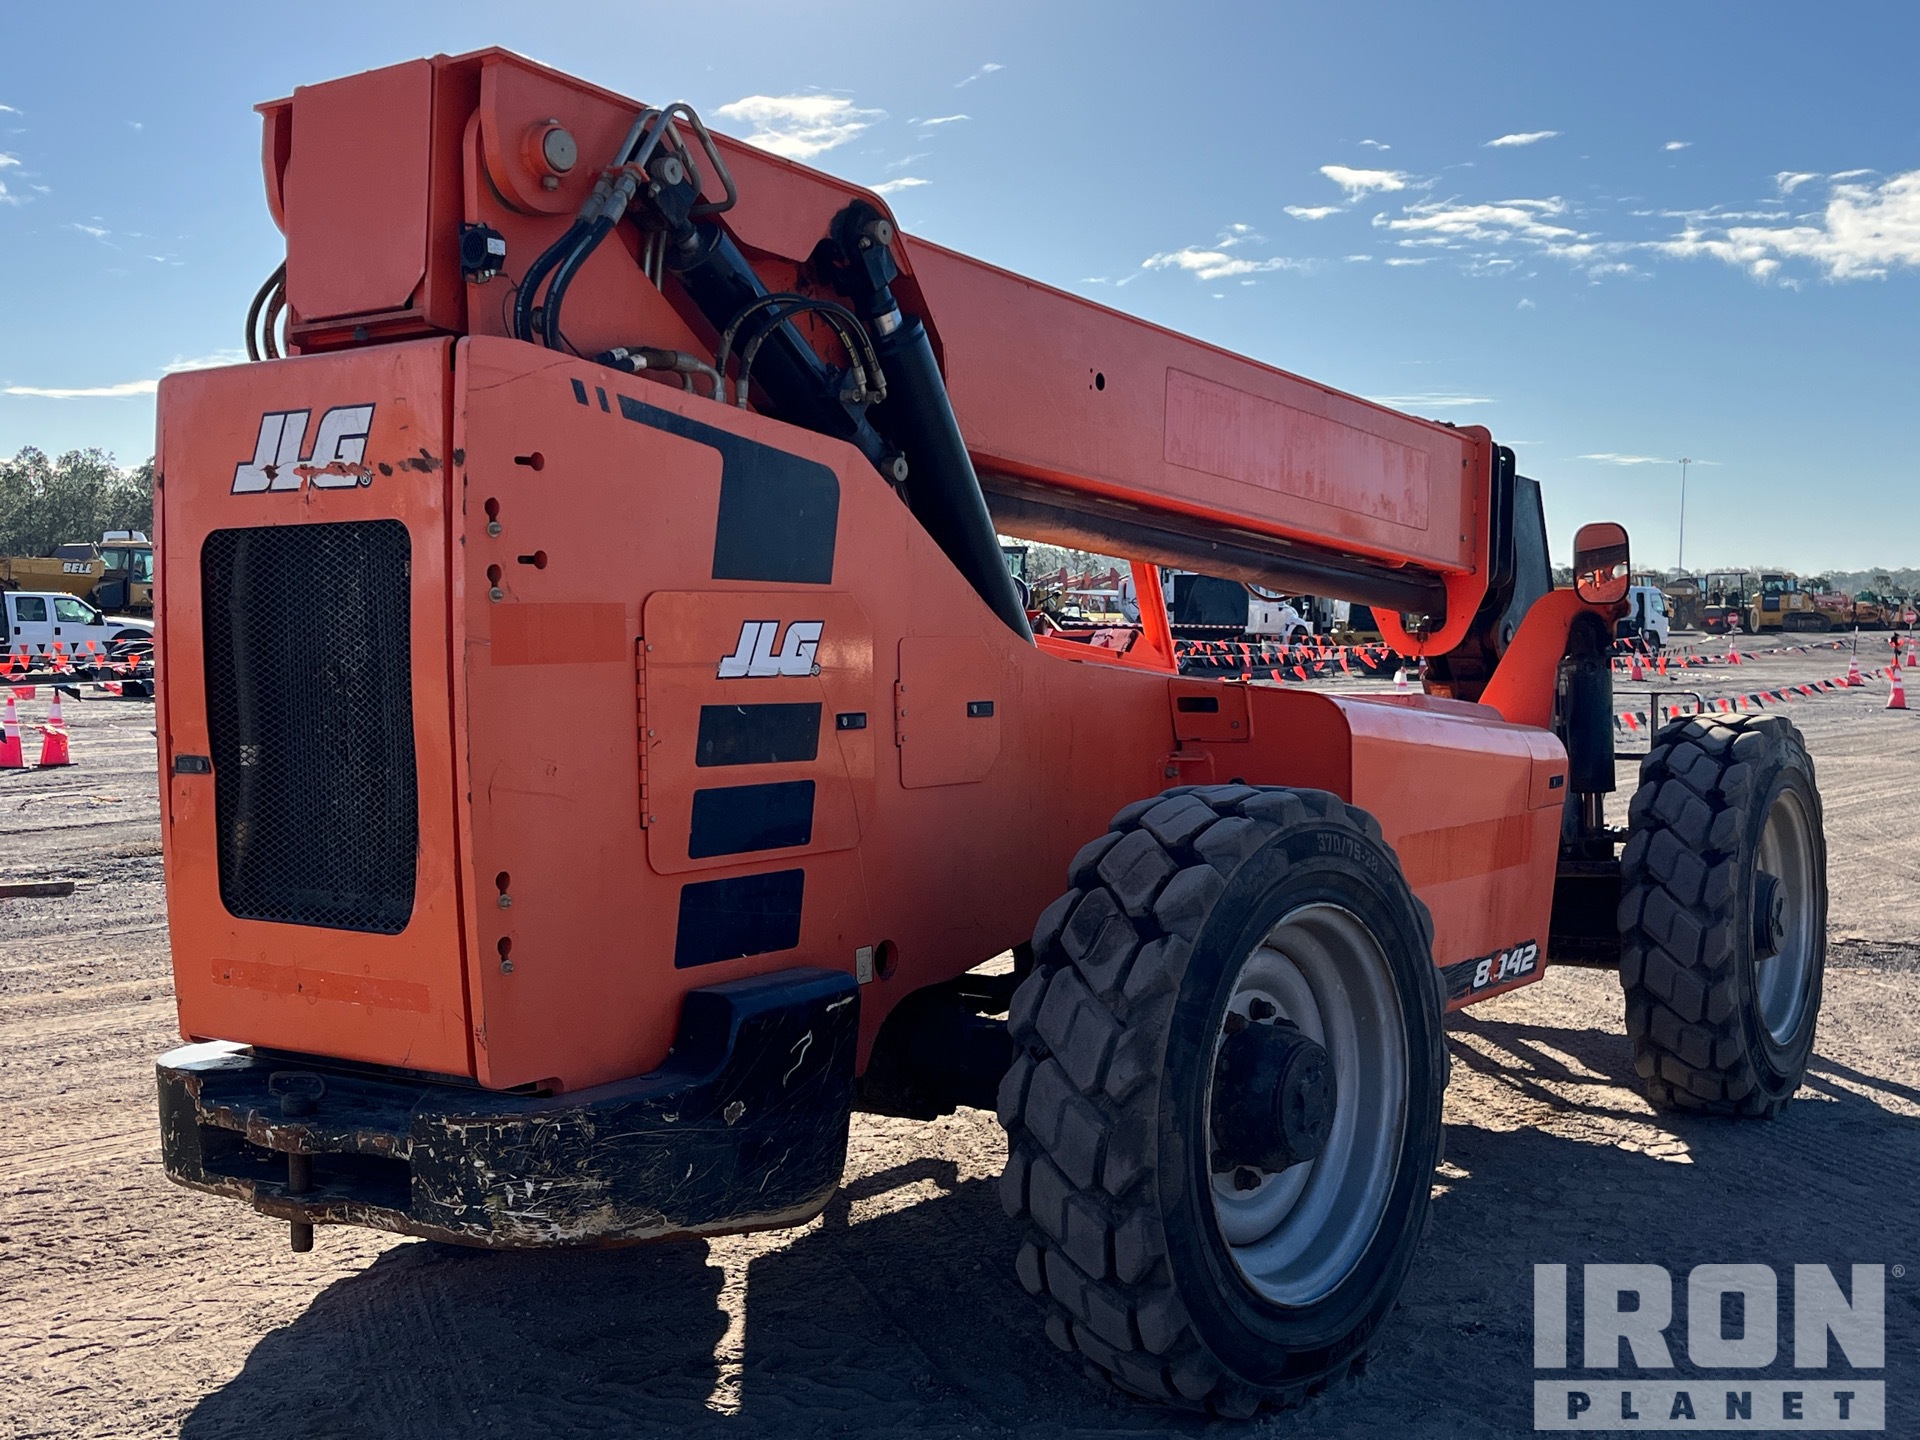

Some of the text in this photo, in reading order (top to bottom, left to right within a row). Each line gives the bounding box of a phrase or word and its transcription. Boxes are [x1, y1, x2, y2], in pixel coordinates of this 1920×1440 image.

[231, 403, 375, 495] JLG
[63, 562, 92, 574] BELL
[716, 620, 824, 680] JLG
